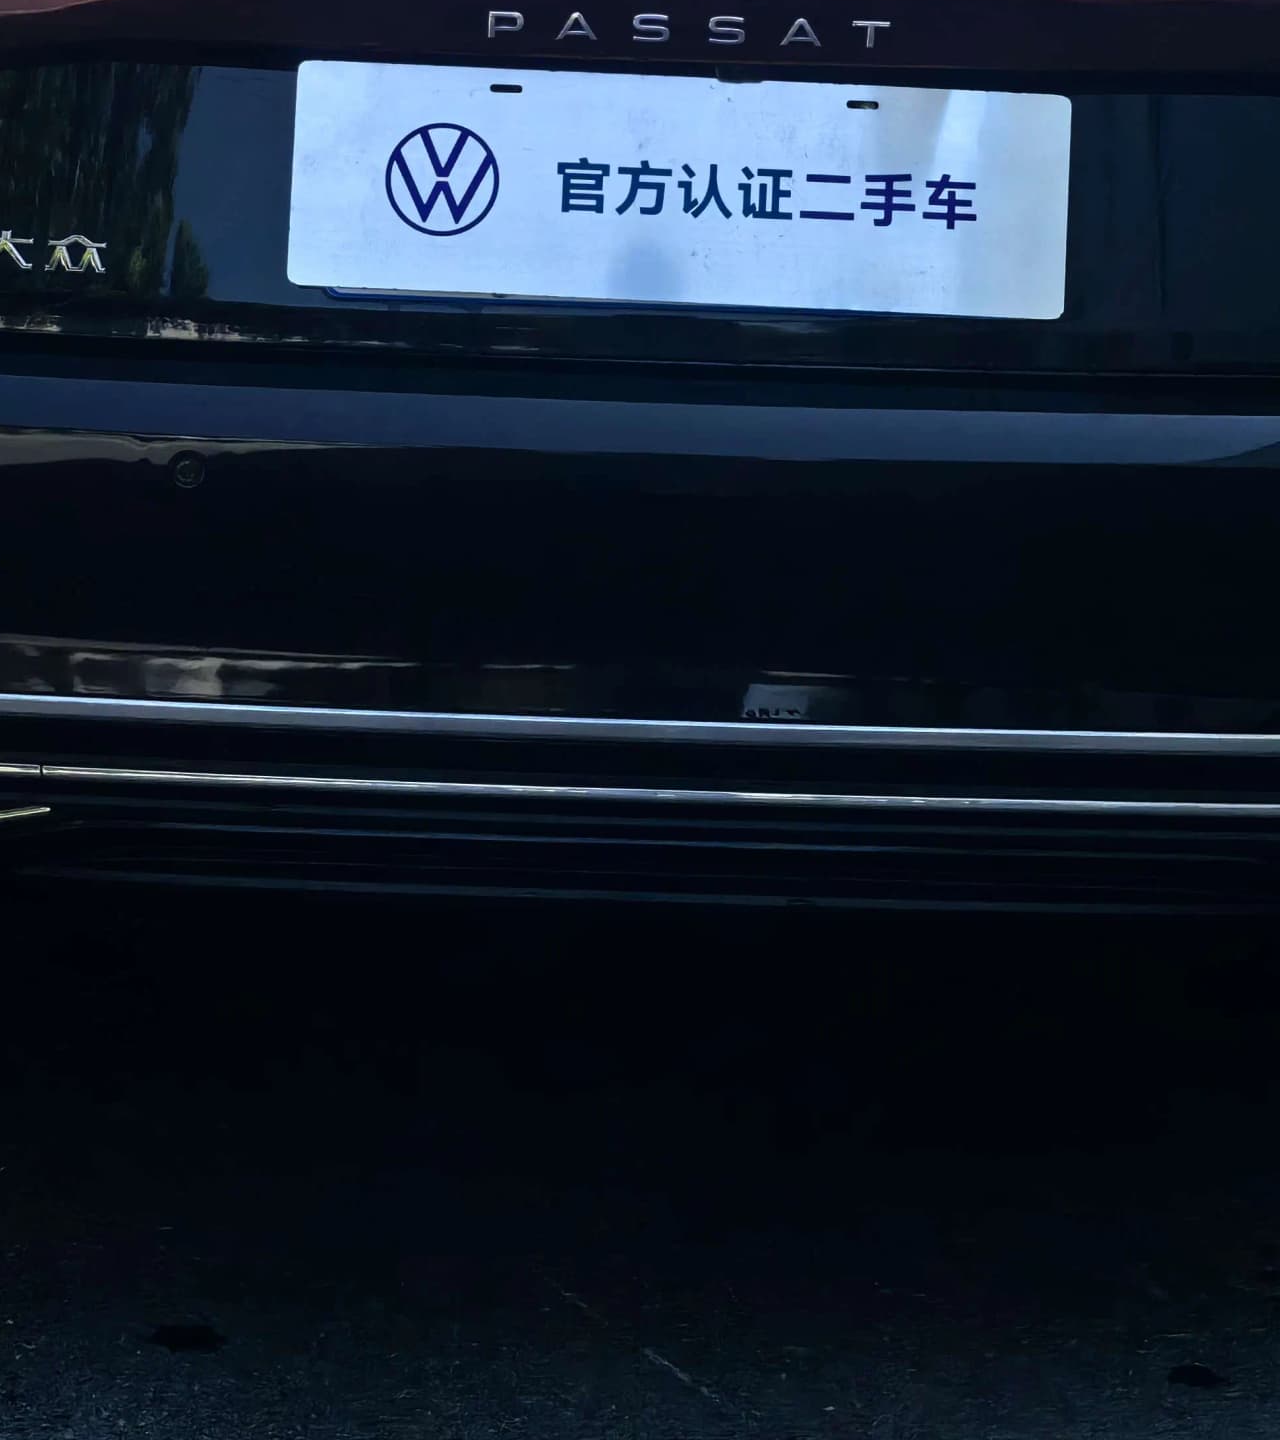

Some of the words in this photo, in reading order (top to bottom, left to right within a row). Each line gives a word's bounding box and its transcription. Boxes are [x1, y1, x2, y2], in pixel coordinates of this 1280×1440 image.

[487, 10, 892, 48] PASSAT
[556, 157, 979, 231] 官方认证二手车
